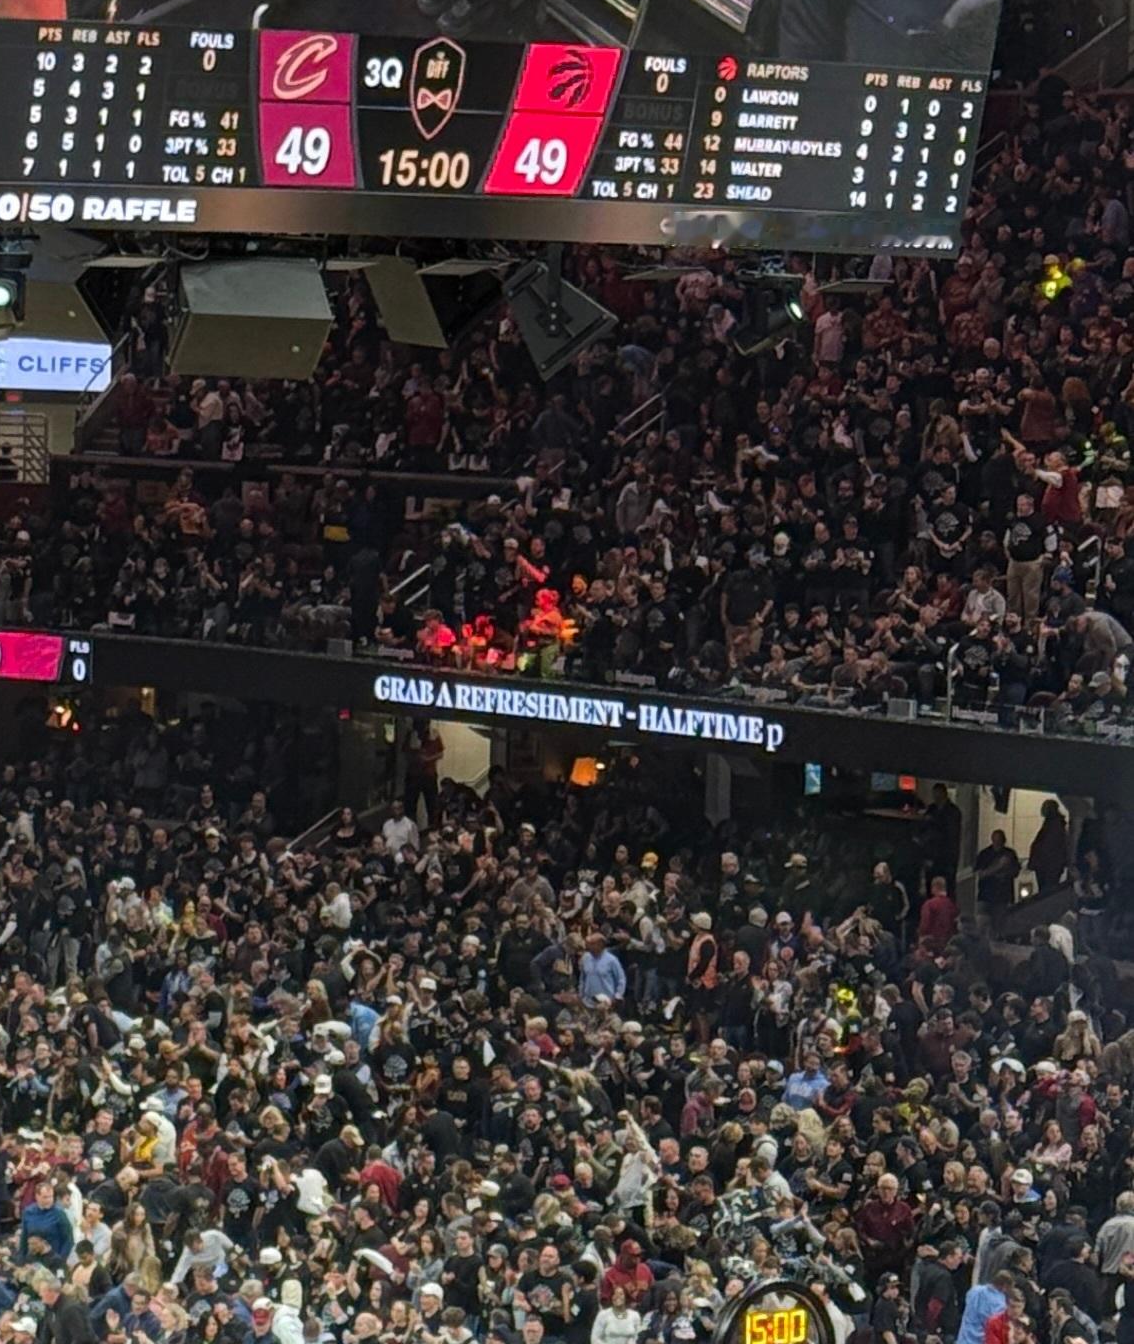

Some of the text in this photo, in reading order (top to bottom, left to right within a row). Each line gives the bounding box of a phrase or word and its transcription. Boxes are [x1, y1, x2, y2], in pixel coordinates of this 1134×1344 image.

[39, 27, 62, 41] PTS
[73, 29, 97, 42] REB
[106, 31, 130, 44] AST
[138, 32, 159, 45] FLS
[191, 32, 234, 49] FOULS
[38, 52, 55, 70] 10
[72, 54, 84, 71] 3
[203, 50, 215, 70] 0
[645, 57, 686, 72] FOULS
[365, 59, 403, 88] 3Q
[657, 73, 668, 92] 0
[747, 63, 982, 92] RAPTORS PTS REB AST FLS
[34, 79, 44, 96] 5
[69, 81, 80, 97] 4
[715, 87, 909, 114] 0 LAWSON 0 1
[30, 105, 41, 123] 5
[65, 106, 77, 124] 3
[170, 111, 238, 129] FG 41
[712, 111, 907, 138] 9 BARRETT 9 3
[26, 131, 37, 149] 6
[62, 133, 74, 150] 5
[165, 138, 236, 155] 3PT 33
[619, 132, 682, 150] FG 44
[704, 135, 904, 162] 12 MURRAY-BOYLES 4 2
[275, 127, 330, 175] 49
[24, 158, 34, 175] 7
[60, 159, 67, 176] 1
[380, 149, 469, 188] 15:00
[515, 138, 567, 184] 49
[615, 157, 679, 174] 3PT 33
[163, 166, 245, 183] TOL 5 CH 1
[701, 160, 897, 185] 14 WALTER 3 1
[593, 181, 673, 198] TOL 5 CH 1
[694, 183, 893, 208] 23 SHEAD 14 1
[83, 200, 197, 221] RAFFLE
[18, 356, 104, 374] CLIFFS
[70, 641, 89, 653] FLS
[73, 659, 85, 680] 0
[374, 676, 434, 707] GRAB
[435, 682, 453, 708] A
[455, 684, 623, 727] REFRESHMENT
[639, 704, 763, 745] HALFTIME
